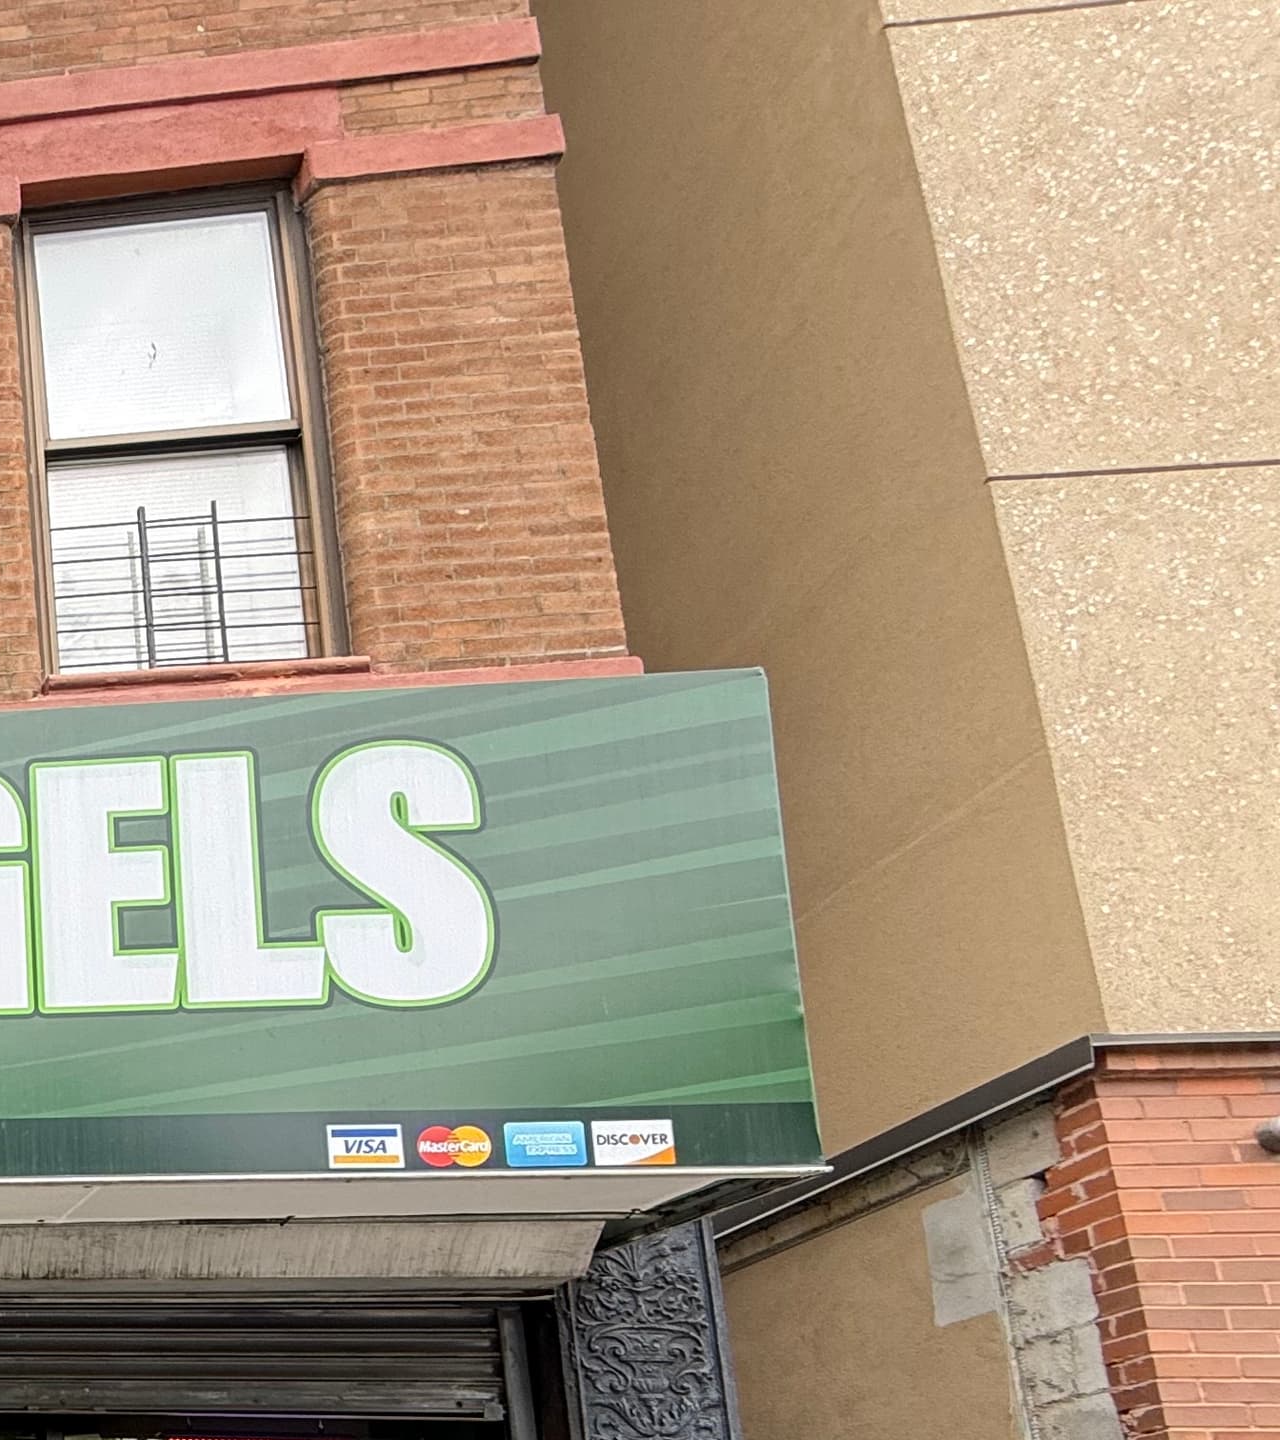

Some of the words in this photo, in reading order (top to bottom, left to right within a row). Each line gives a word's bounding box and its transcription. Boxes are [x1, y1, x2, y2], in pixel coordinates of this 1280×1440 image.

[344, 1138, 387, 1154] VISA
[513, 1132, 572, 1146] AMERICAN
[596, 1132, 669, 1147] DISCOVER
[419, 1140, 491, 1154] MasterCard
[527, 1144, 579, 1156] EXPRESS
